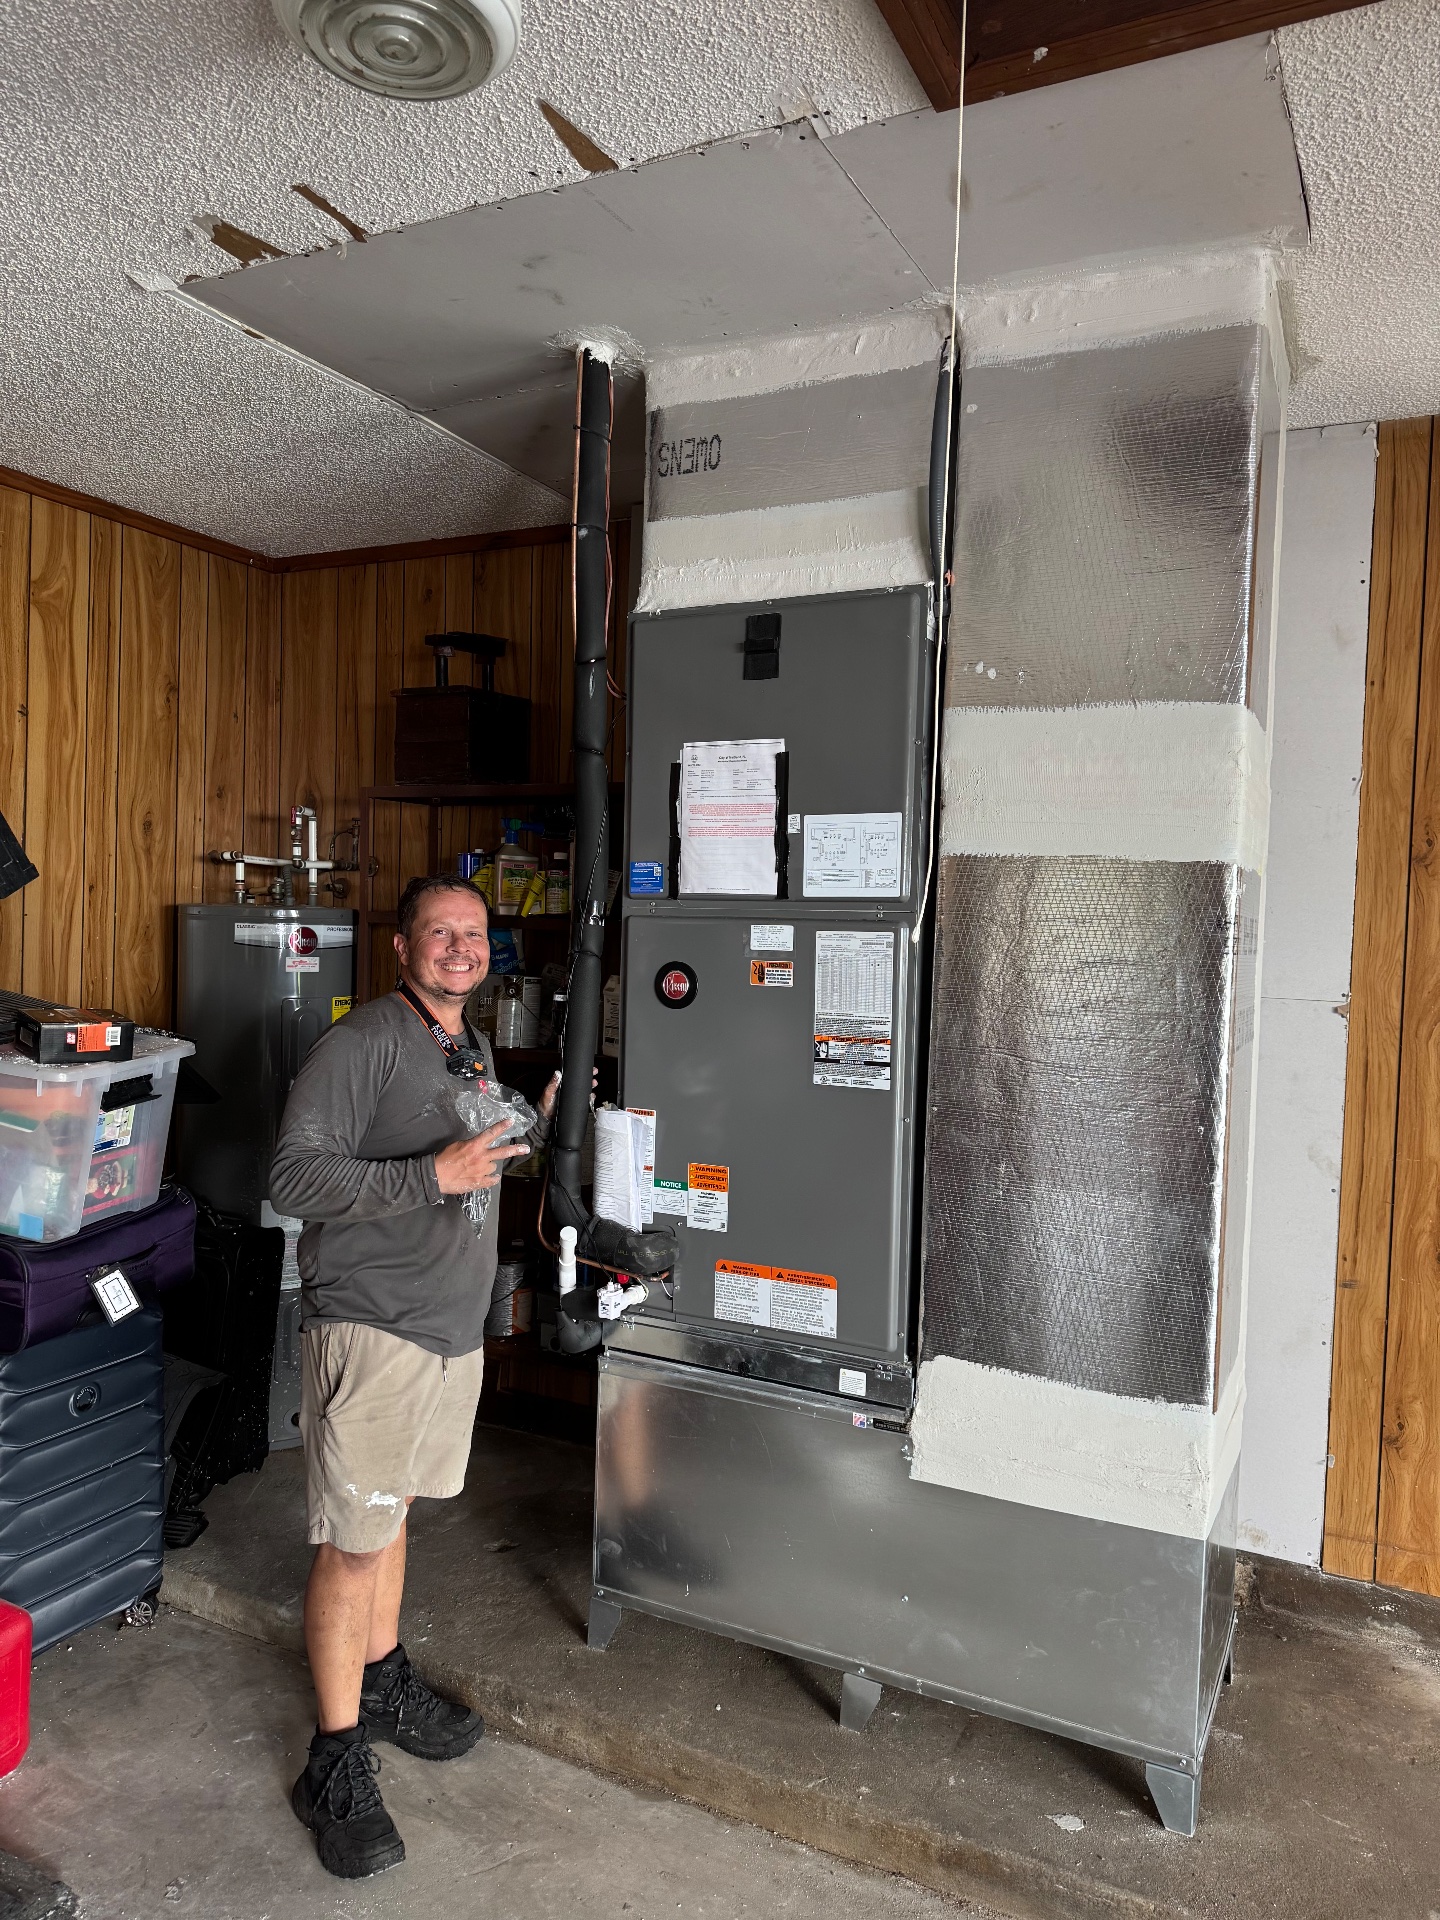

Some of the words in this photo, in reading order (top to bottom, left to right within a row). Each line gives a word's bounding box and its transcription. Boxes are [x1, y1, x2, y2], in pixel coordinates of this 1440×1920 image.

[657, 434, 722, 477] OWENS
[292, 928, 317, 950] Rheem
[665, 973, 688, 994] Rheem
[434, 1023, 451, 1045] KLEIN
[695, 1166, 727, 1175] WARNING
[660, 1180, 682, 1189] NOTICE
